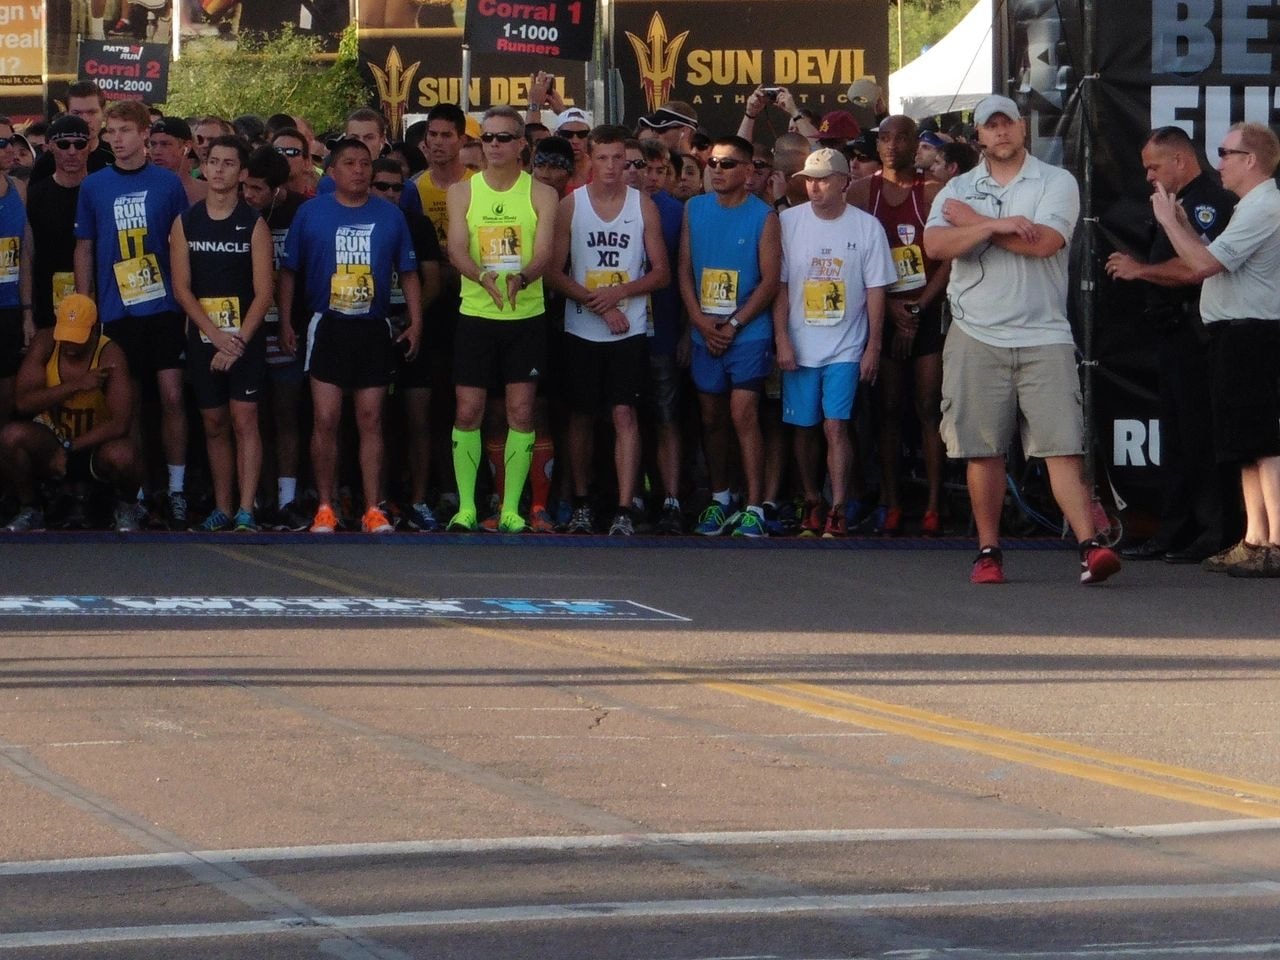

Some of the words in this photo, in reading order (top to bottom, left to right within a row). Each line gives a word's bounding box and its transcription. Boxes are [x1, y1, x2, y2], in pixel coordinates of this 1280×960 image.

[568, 0, 582, 25] 1
[503, 23, 558, 42] 1-1000
[103, 44, 130, 53] PAT'S
[496, 38, 561, 56] Runners
[84, 59, 140, 77] Corral
[146, 60, 161, 79] 2
[686, 49, 764, 87] SUN
[773, 49, 877, 86] DEVIL
[418, 76, 480, 108] SUN
[490, 76, 575, 106] DEL
[692, 93, 869, 104] ATHTICS
[1150, 85, 1280, 171] FU
[114, 203, 147, 220] RUN
[116, 216, 148, 232] WITH
[118, 228, 148, 259] IT
[188, 241, 250, 254] PINNACLE
[335, 235, 371, 251] RUN
[586, 231, 631, 249] JAGS
[335, 251, 371, 264] WITH
[597, 251, 620, 267] XC
[128, 269, 151, 288] 859
[819, 267, 840, 277] RUN
[705, 282, 727, 300] 726
